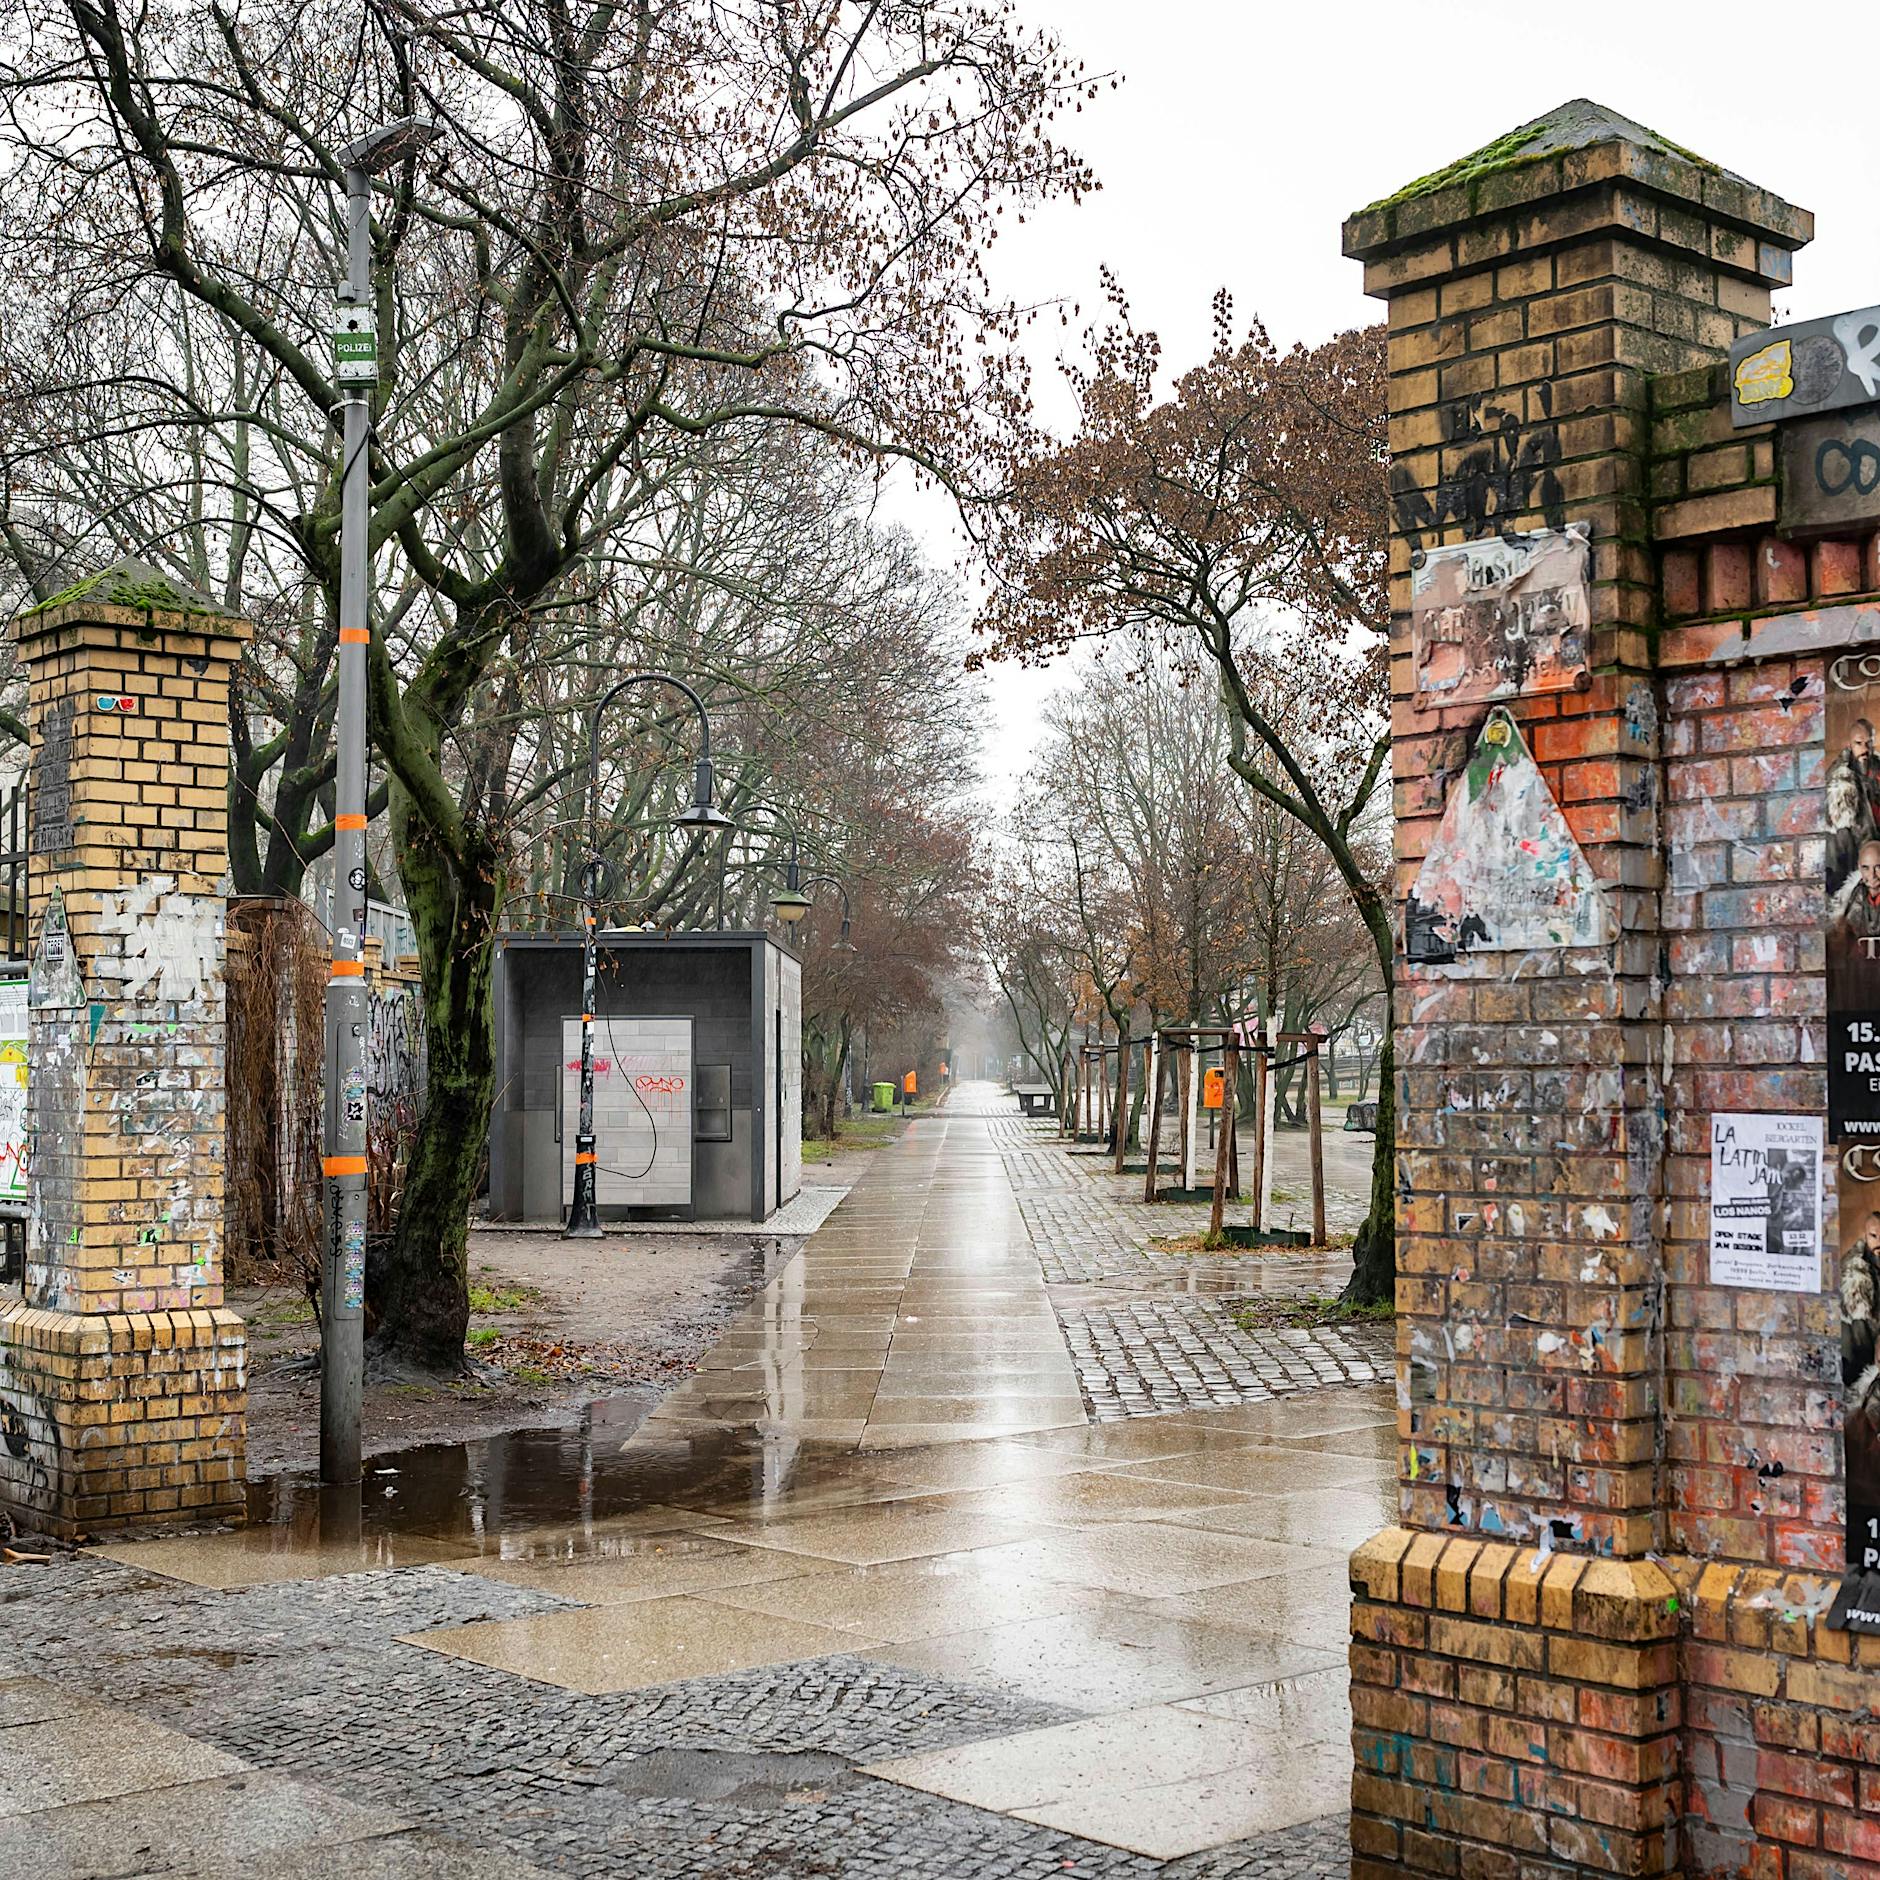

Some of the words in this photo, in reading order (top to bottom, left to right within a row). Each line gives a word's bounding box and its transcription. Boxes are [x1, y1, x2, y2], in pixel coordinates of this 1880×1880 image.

[337, 343, 372, 352] POLIZEI
[1846, 1021, 1880, 1043] 15.
[1715, 1123, 1736, 1144] LA
[1765, 1133, 1817, 1145] BIERGARTEN
[1714, 1206, 1735, 1217] LOS
[1714, 1230, 1734, 1239] OPEN
[1737, 1232, 1763, 1241] STAGE
